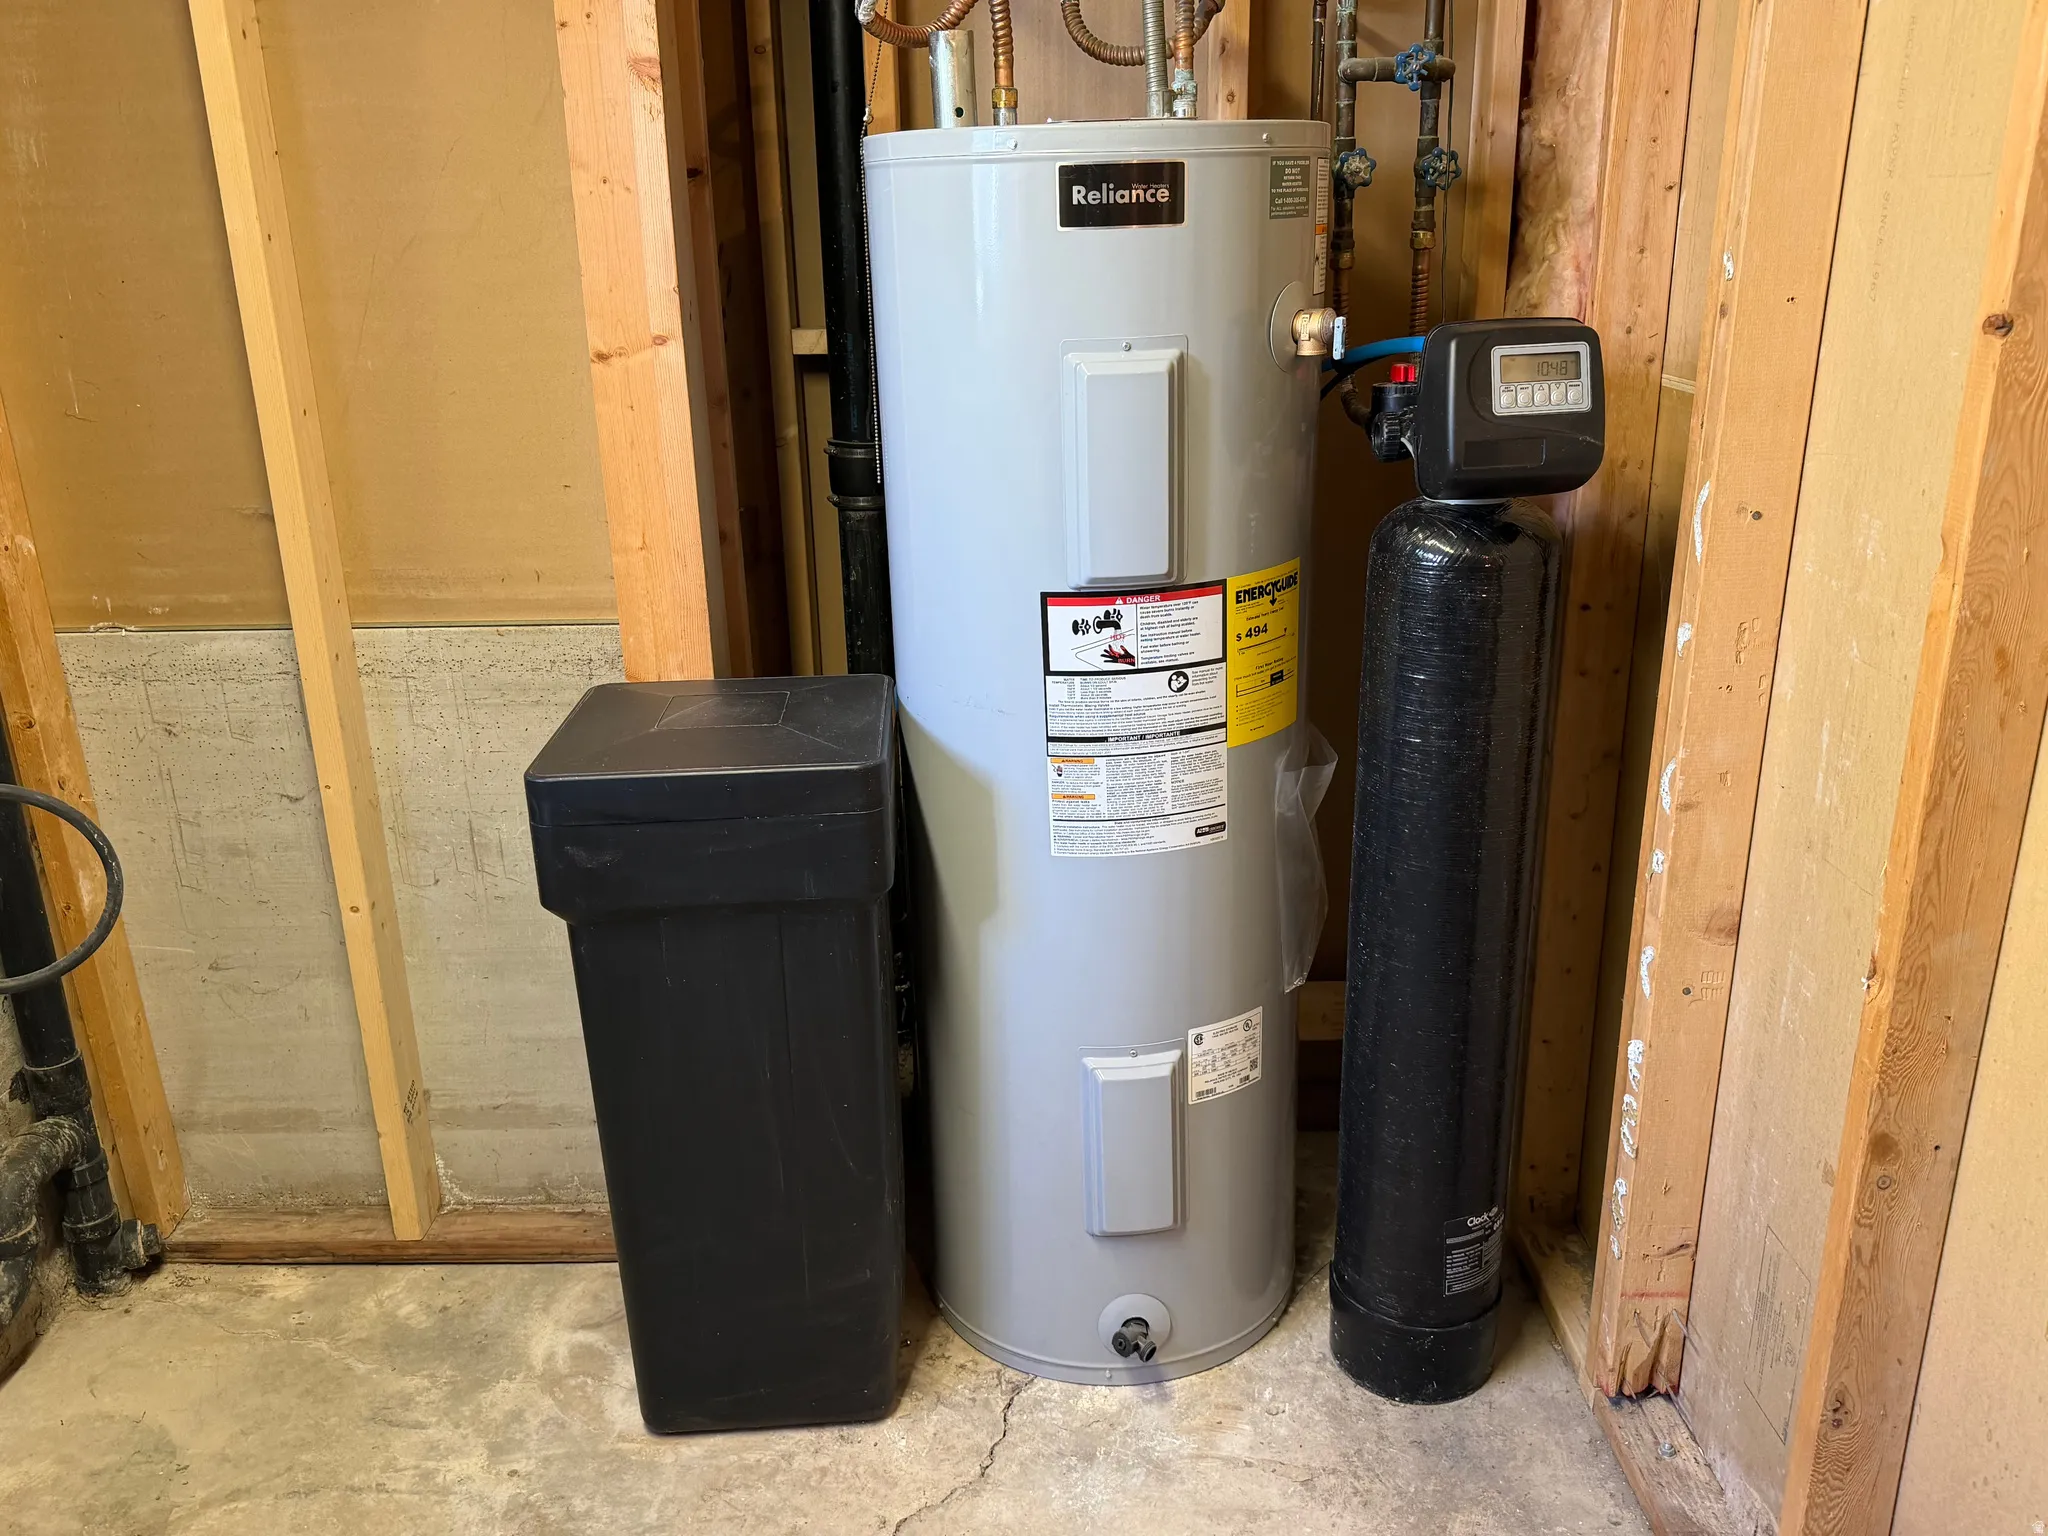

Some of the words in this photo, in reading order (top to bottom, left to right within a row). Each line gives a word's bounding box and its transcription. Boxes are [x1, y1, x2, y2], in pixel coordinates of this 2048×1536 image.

[1072, 183, 1170, 204] Reliance
[1236, 571, 1299, 606] ENERGYGUIDE
[1126, 595, 1160, 604] DANGER
[1245, 623, 1268, 639] 494
[1145, 731, 1180, 740] IMPORTANTE
